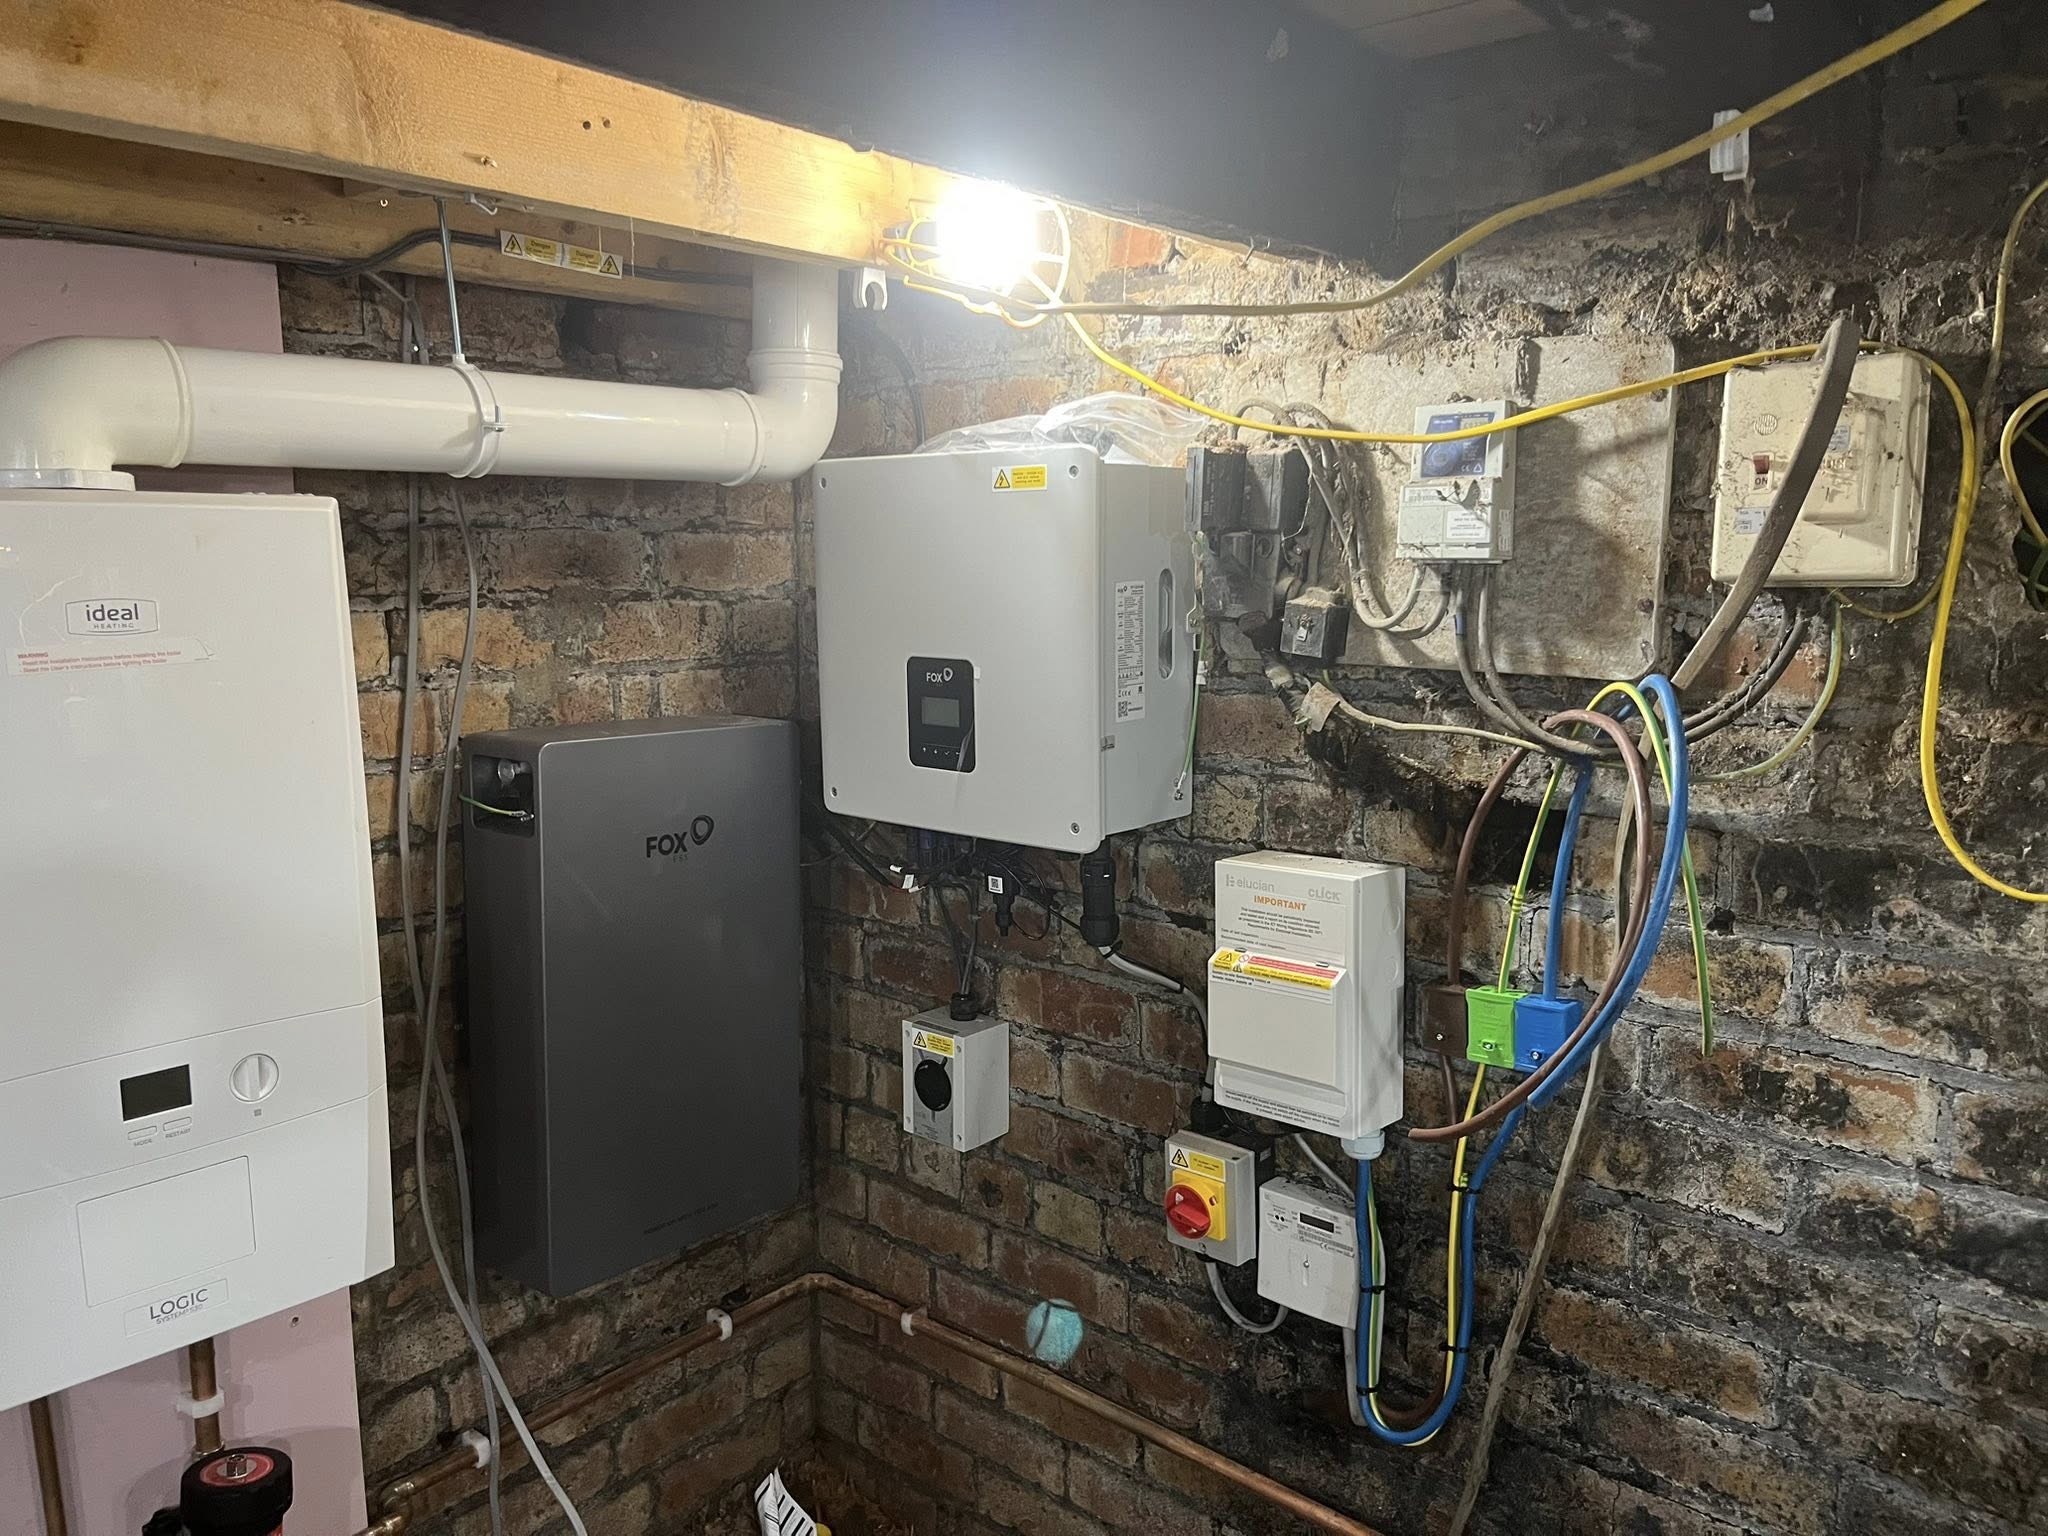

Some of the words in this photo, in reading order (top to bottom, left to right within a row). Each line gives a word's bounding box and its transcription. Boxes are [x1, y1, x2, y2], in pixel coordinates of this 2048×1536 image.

[1754, 477, 1768, 486] ON
[85, 603, 139, 622] ideal
[926, 672, 943, 683] FOX
[646, 831, 688, 858] FOX
[1236, 877, 1275, 893] elucian
[1253, 895, 1307, 911] IMPORTANT
[165, 1128, 191, 1139] RESTART
[133, 1138, 153, 1147] MODE
[149, 1288, 209, 1320] LOGIC
